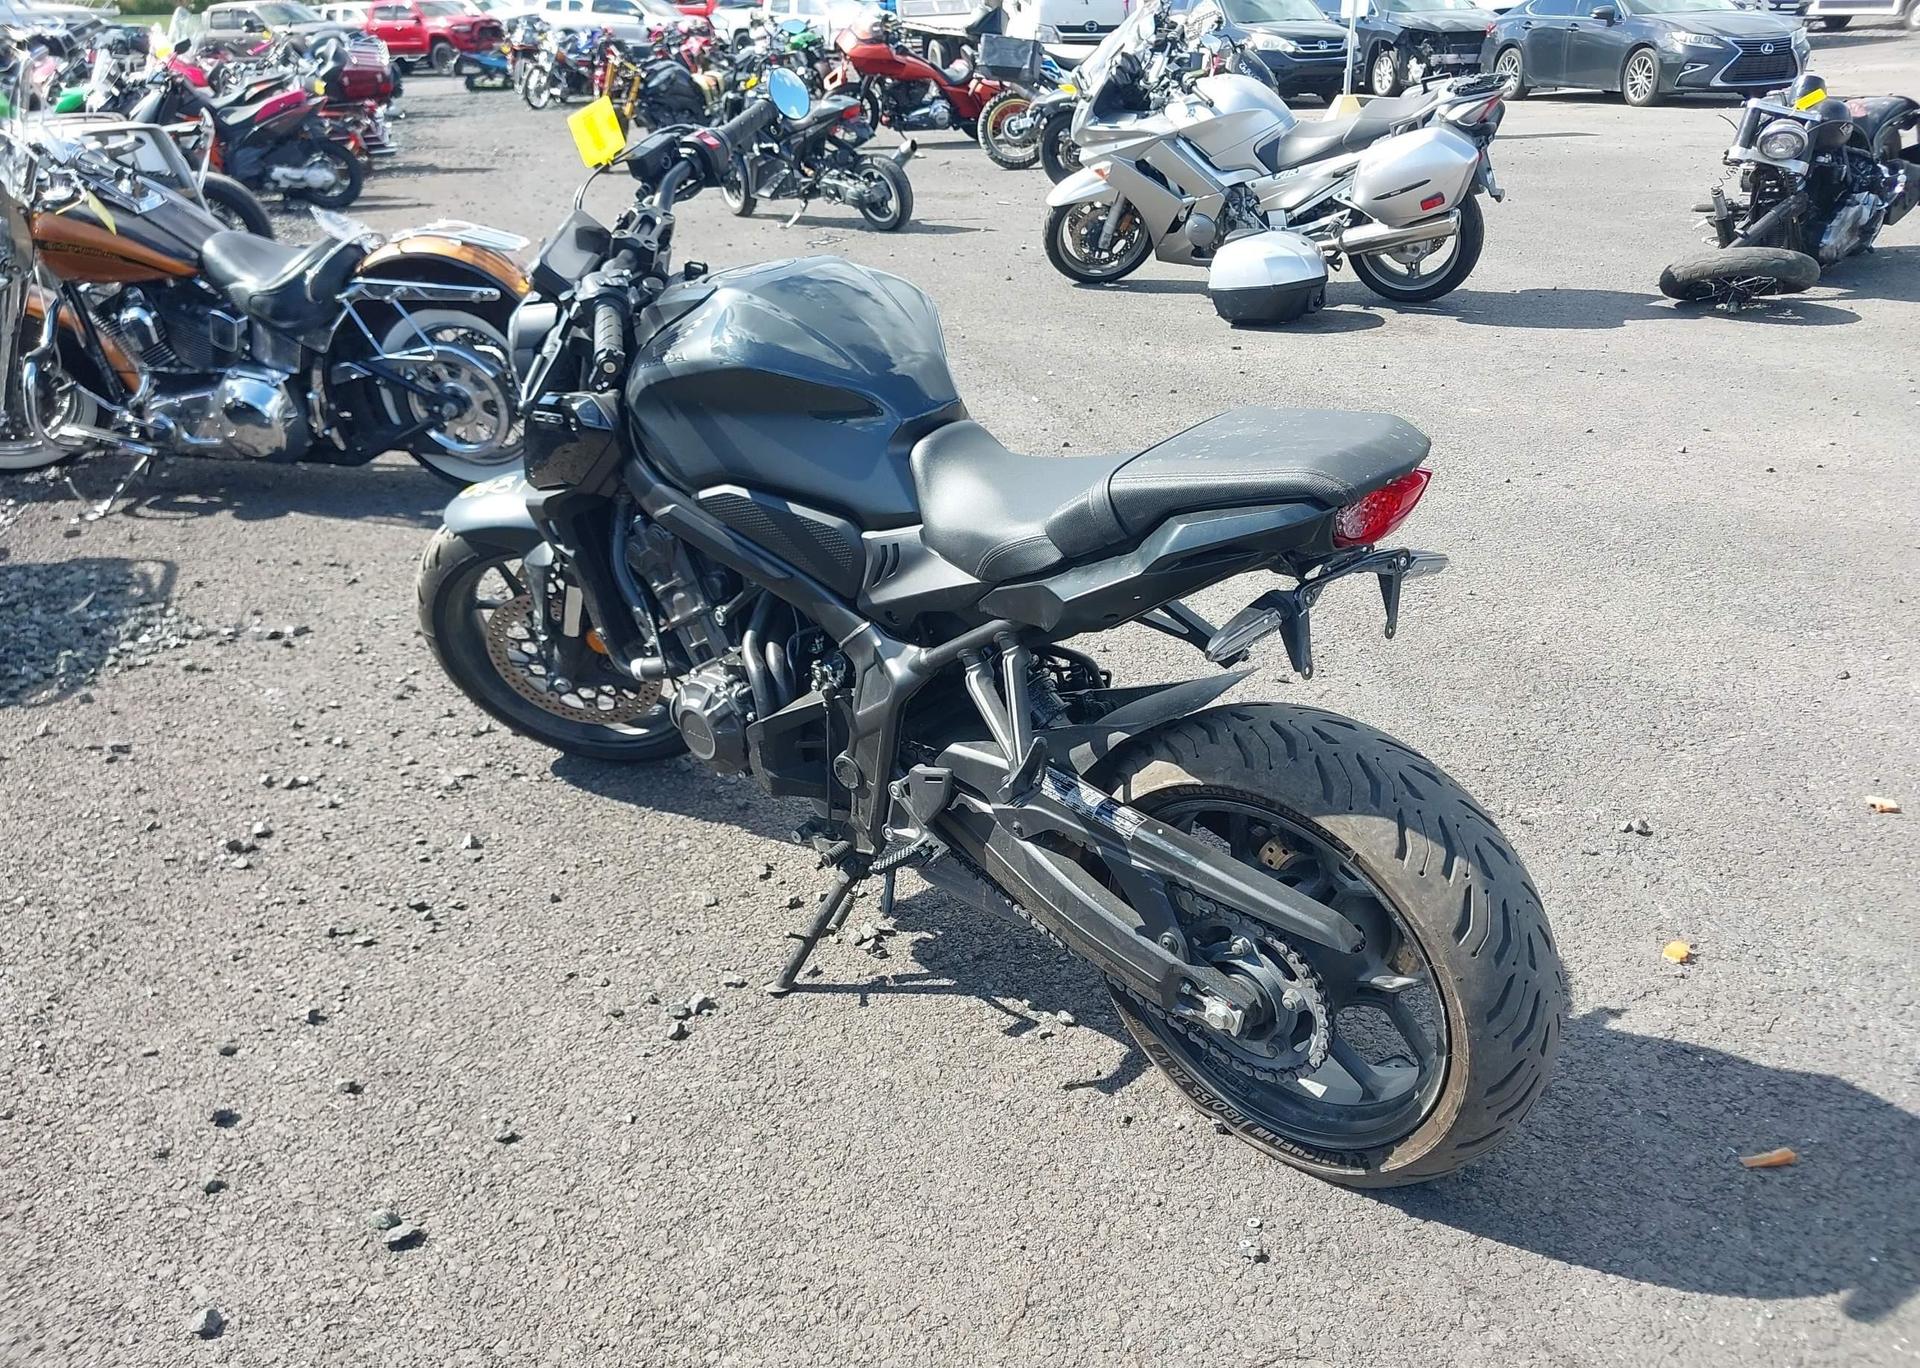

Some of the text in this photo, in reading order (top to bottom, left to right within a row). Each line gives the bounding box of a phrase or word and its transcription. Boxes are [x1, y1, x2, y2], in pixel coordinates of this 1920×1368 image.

[1151, 1046, 1171, 1066] 17
[1168, 1066, 1193, 1086] ZR
[1188, 1084, 1244, 1125] 180/55
[1250, 1126, 1342, 1167] MICHELIN
